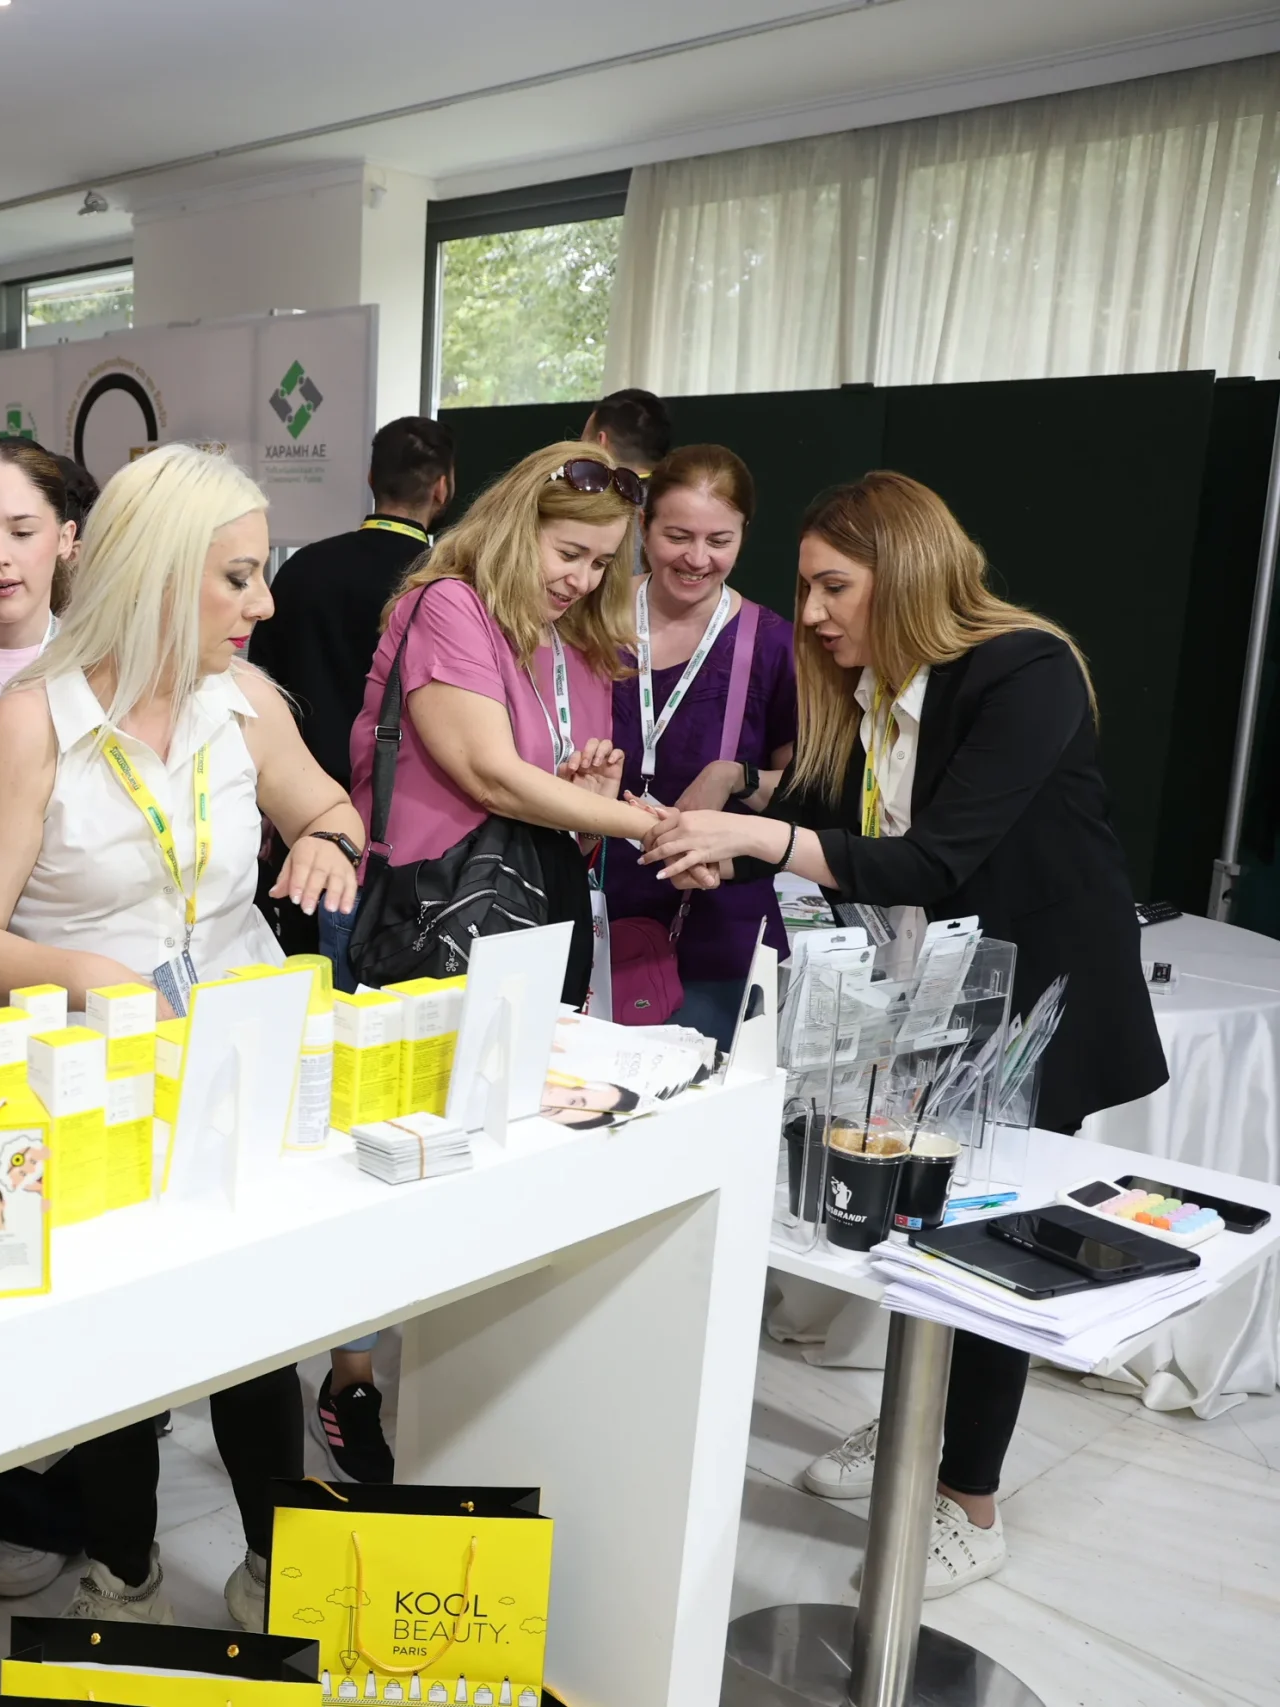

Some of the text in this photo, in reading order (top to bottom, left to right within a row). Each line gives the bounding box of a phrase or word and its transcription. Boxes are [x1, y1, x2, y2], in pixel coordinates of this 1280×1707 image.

[265, 443, 326, 459] ΧΑΡΑΜΗ ΑΕ
[395, 1590, 488, 1617] KOOL
[394, 1619, 510, 1644] BEAUTY.
[393, 1646, 427, 1656] PARIS
